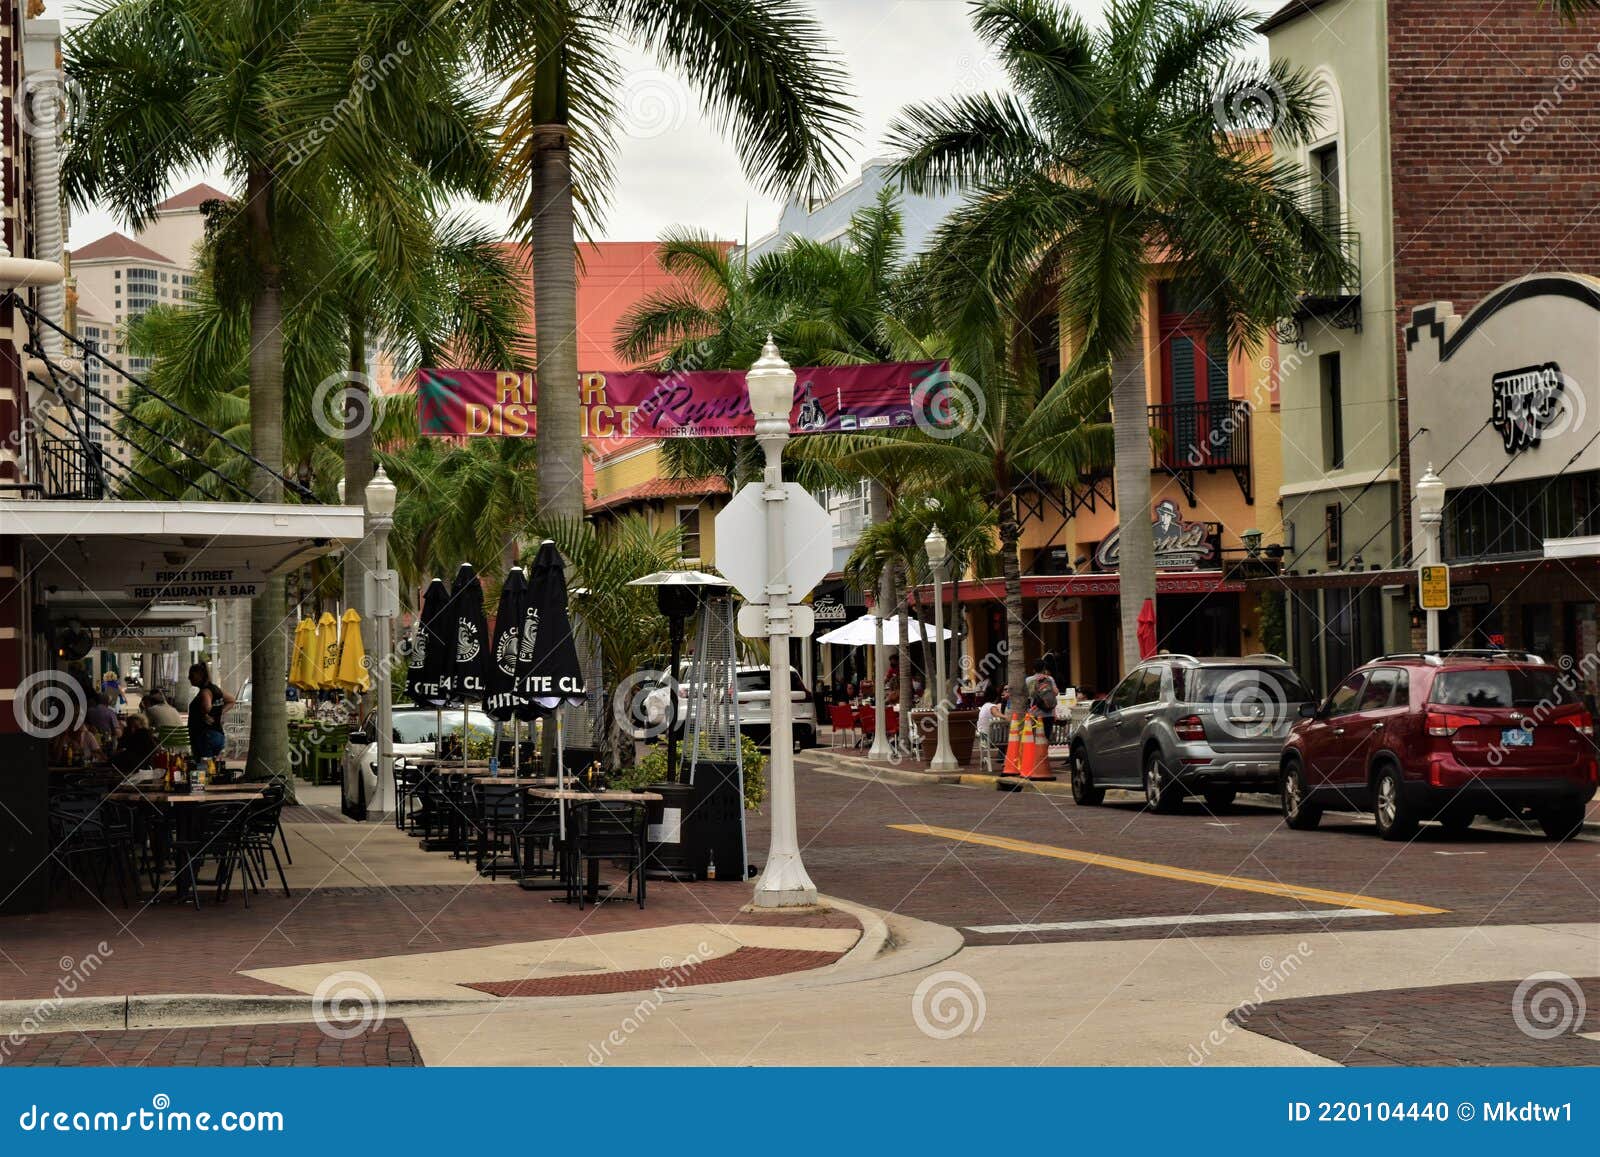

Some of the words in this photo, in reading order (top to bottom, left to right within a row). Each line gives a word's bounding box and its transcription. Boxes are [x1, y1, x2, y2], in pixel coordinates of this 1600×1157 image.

[496, 372, 607, 404] RIR
[466, 403, 638, 437] DISICT
[156, 571, 188, 582] FIRST
[190, 570, 233, 581] STREET
[1423, 568, 1430, 580] 2
[134, 586, 213, 598] RESTAURANT
[217, 586, 227, 596] &
[230, 585, 256, 595] BAR
